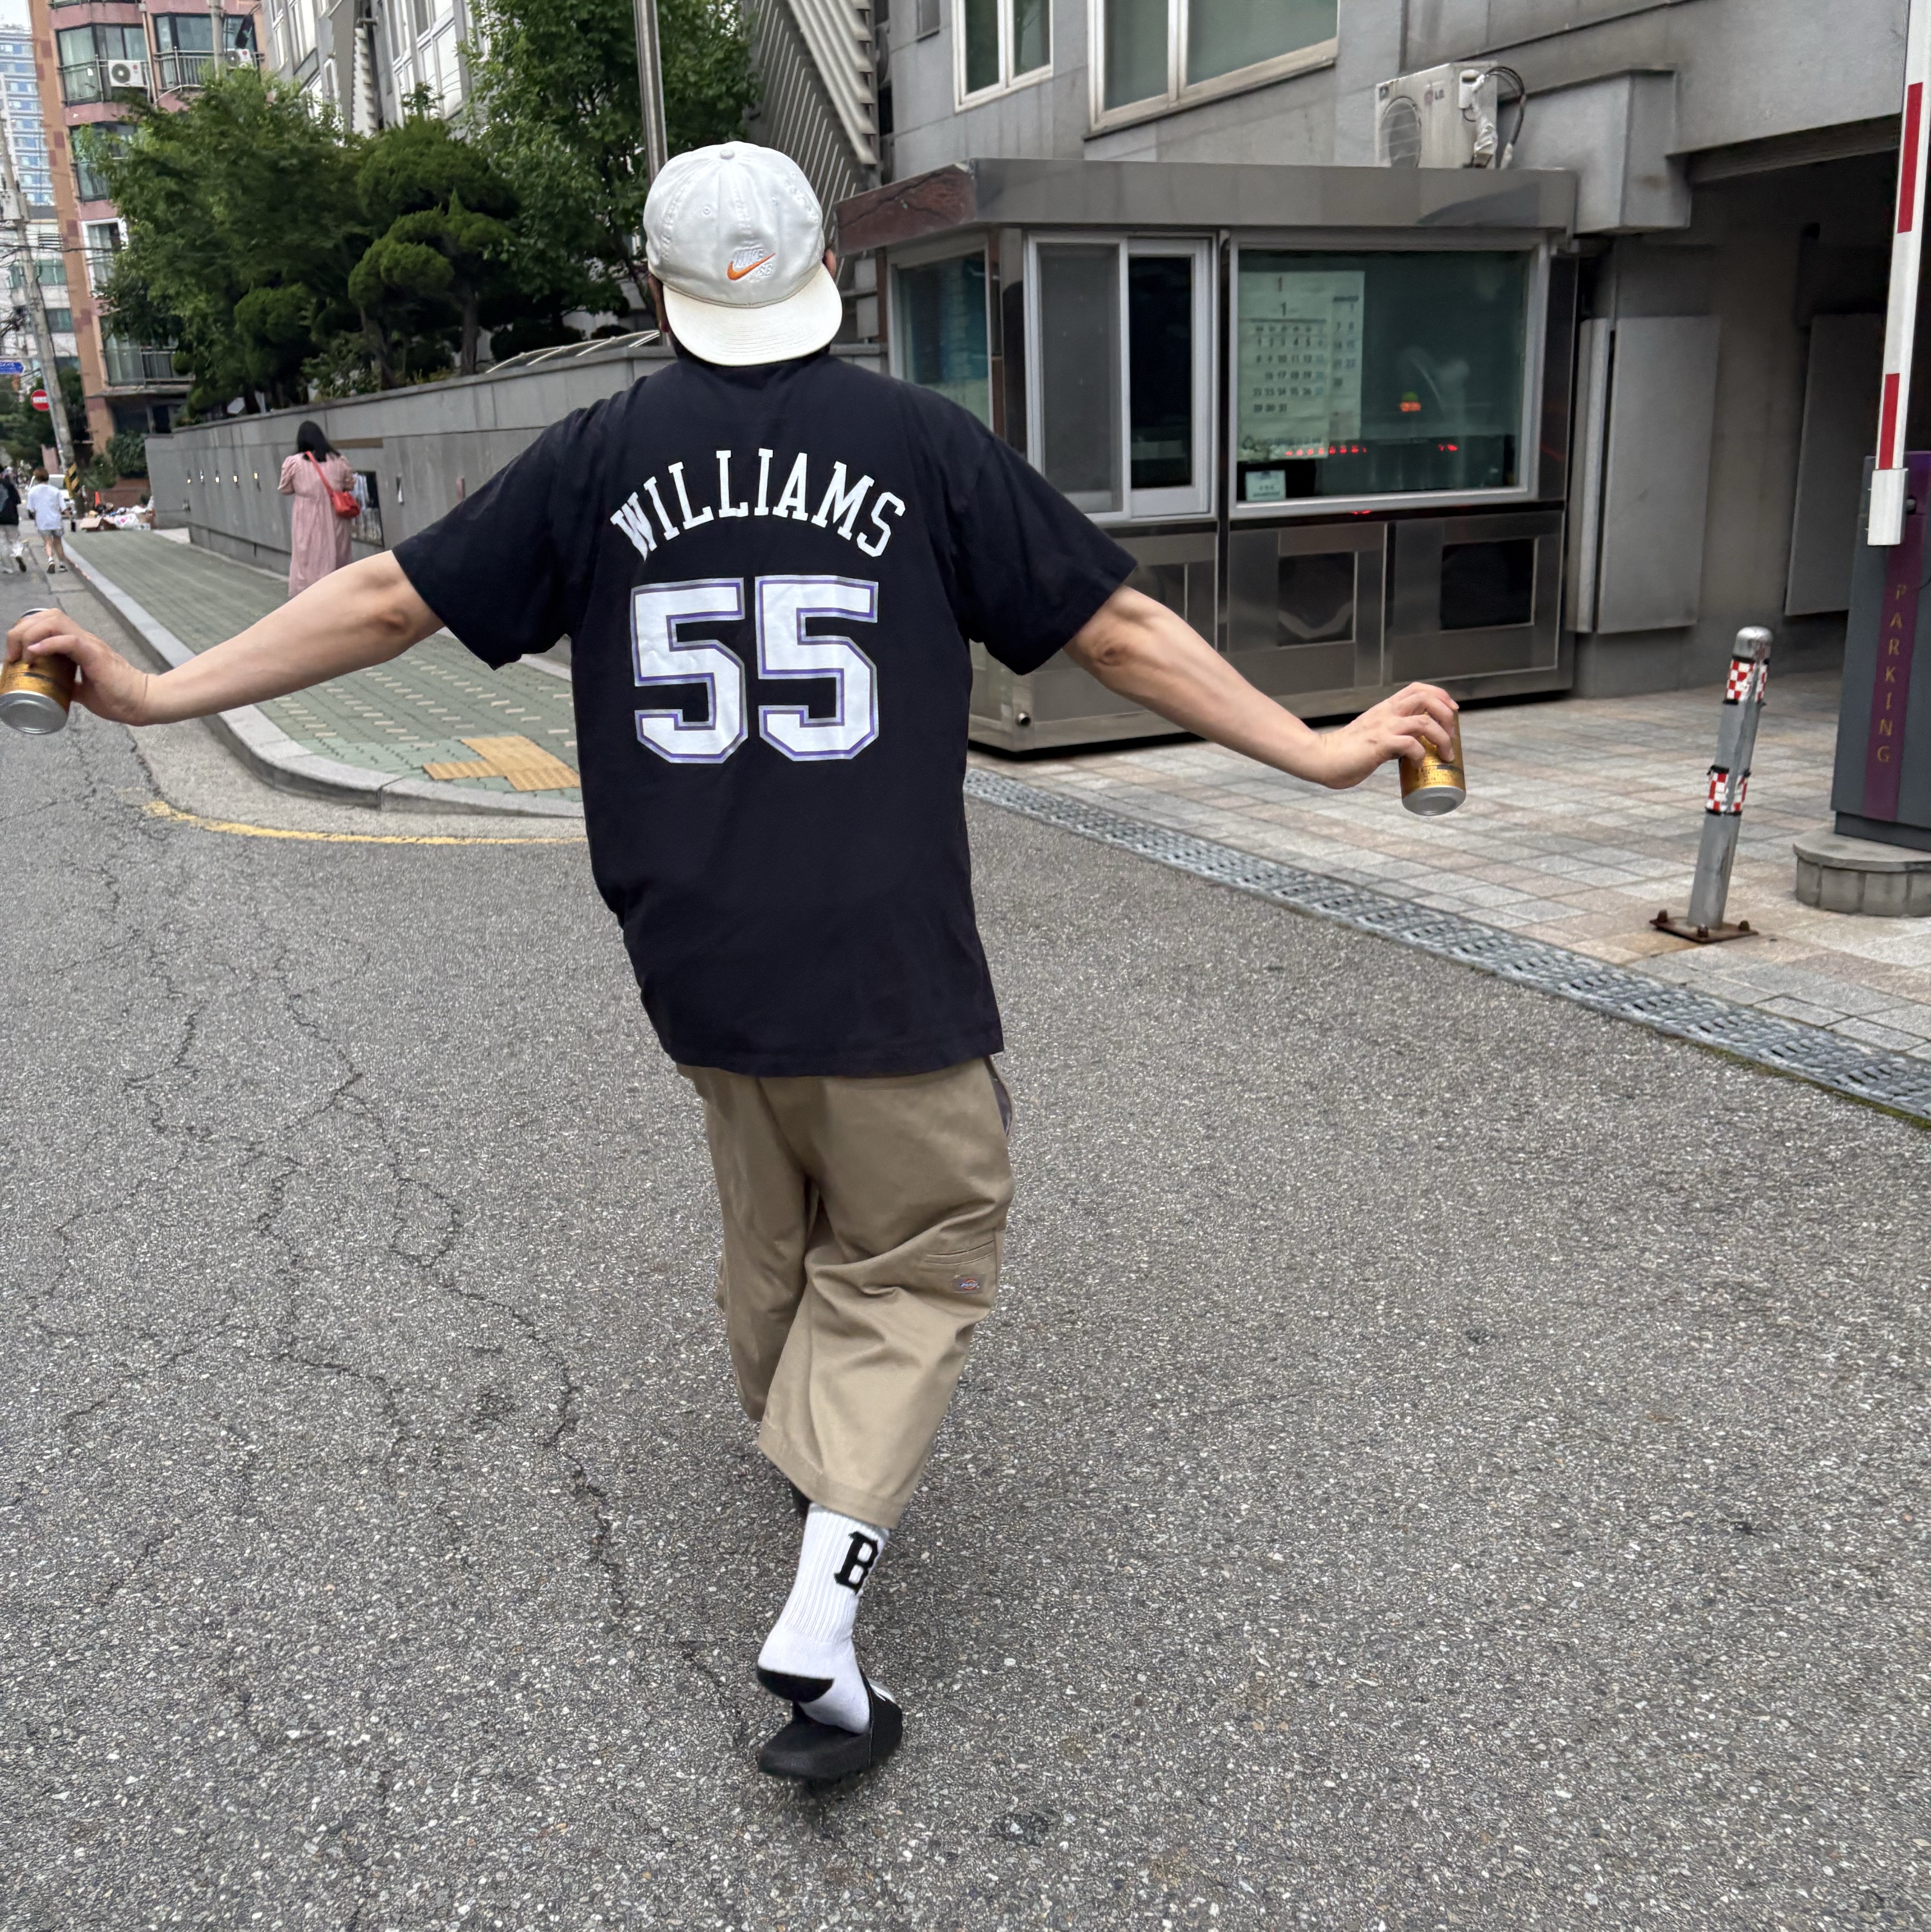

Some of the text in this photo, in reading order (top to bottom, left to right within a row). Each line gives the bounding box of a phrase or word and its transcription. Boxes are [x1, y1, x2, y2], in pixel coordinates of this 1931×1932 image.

[610, 448, 906, 562] WILLIAMS
[630, 575, 880, 764] 55
[1876, 584, 1908, 762] PARKING
[833, 1531, 879, 1596] B
